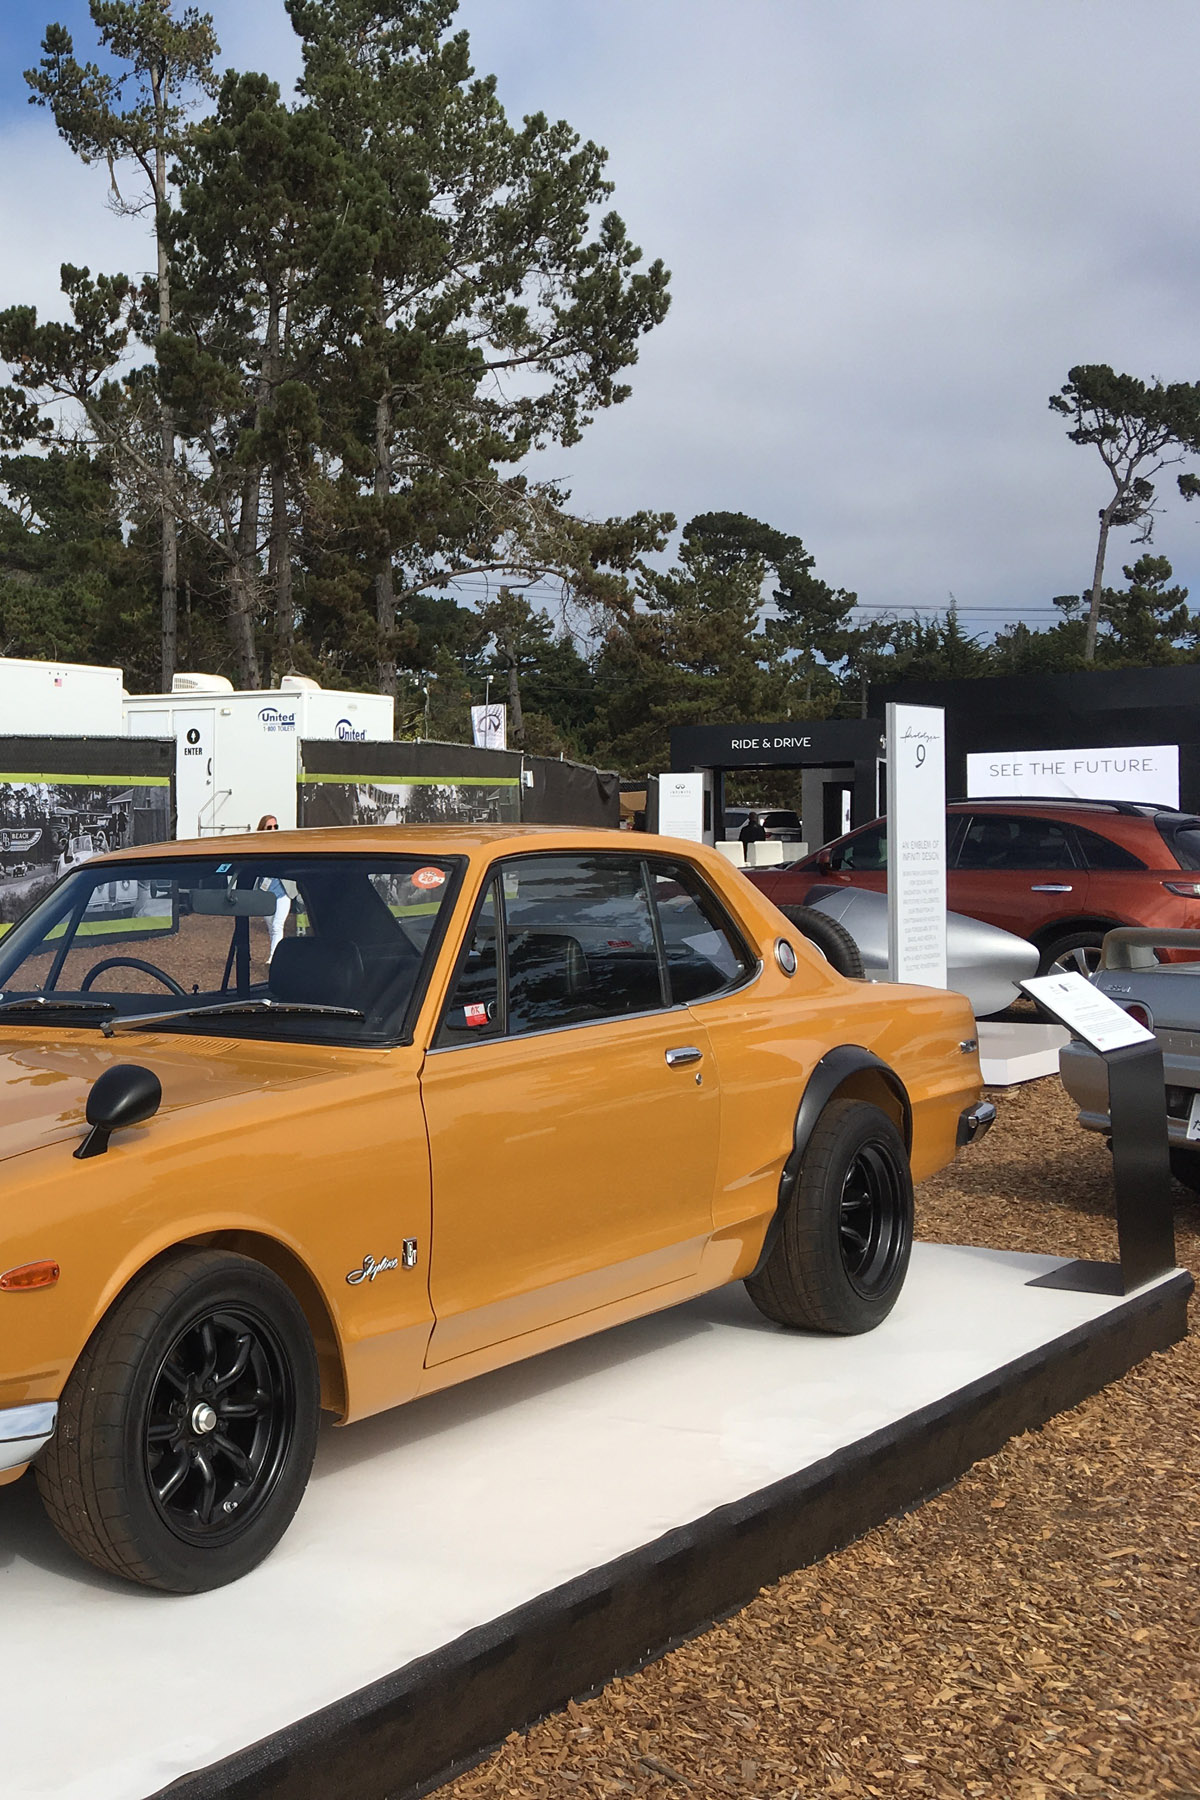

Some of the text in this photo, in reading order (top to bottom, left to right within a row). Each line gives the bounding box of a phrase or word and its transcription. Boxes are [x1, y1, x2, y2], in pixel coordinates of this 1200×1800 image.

[262, 713, 295, 722] United
[338, 727, 366, 740] United
[731, 737, 812, 749] RIDE & DRIVE
[184, 747, 203, 756] ENTER
[915, 744, 926, 768] 9
[989, 758, 1159, 777] SEE THE FUTURE.
[345, 1253, 399, 1286] Skyline
